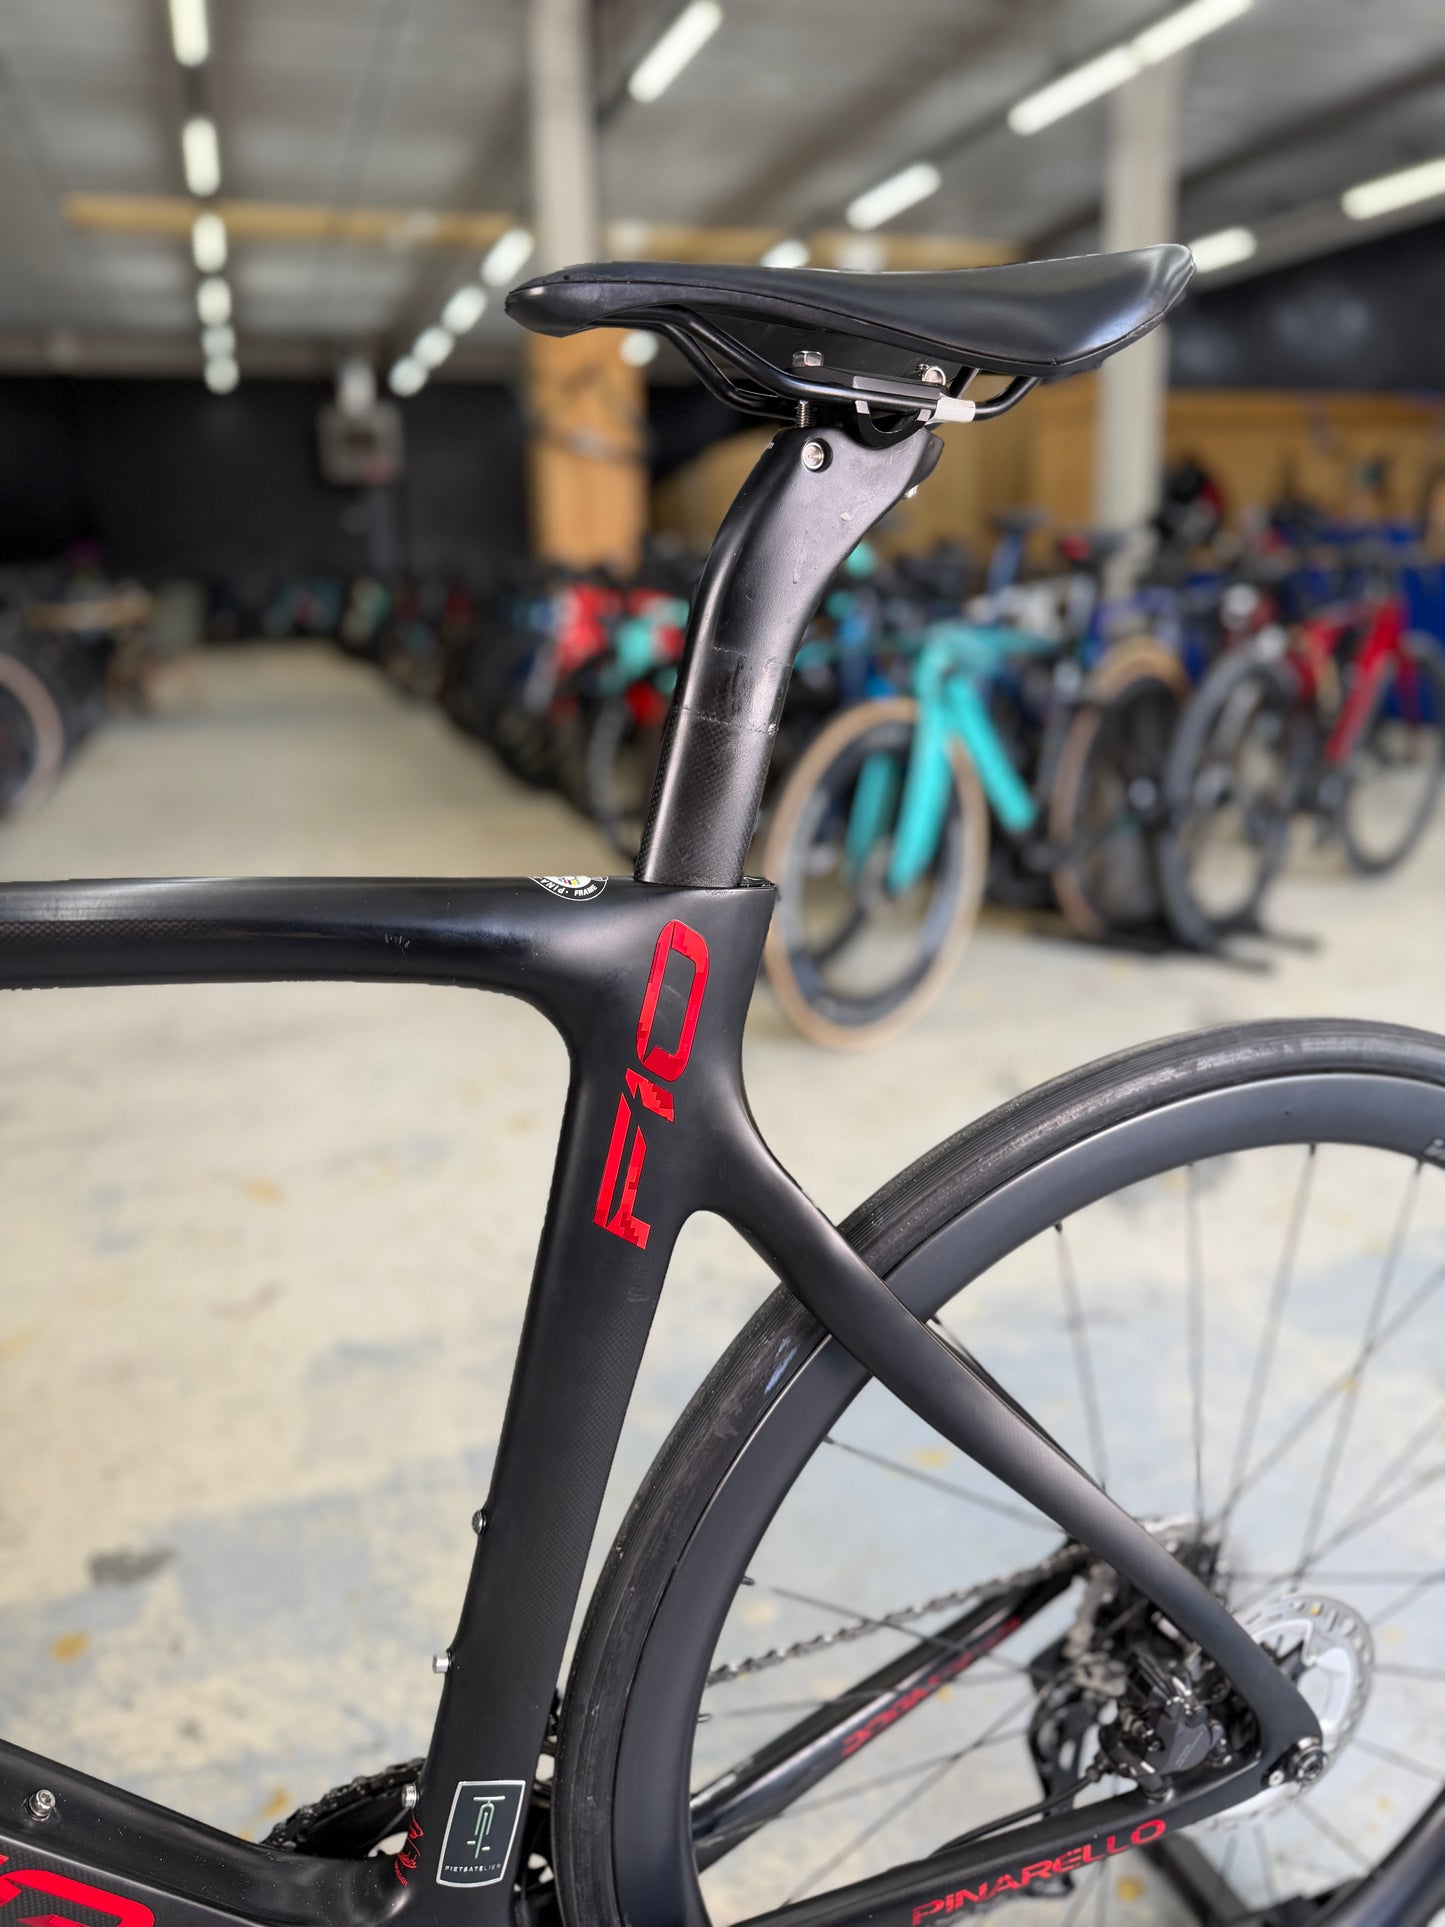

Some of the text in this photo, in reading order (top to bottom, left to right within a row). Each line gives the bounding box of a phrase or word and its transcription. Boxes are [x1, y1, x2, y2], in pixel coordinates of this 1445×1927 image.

[574, 884, 598, 897] FRAME
[592, 919, 710, 1250] F10
[444, 1863, 503, 1873] FIETSATELIER
